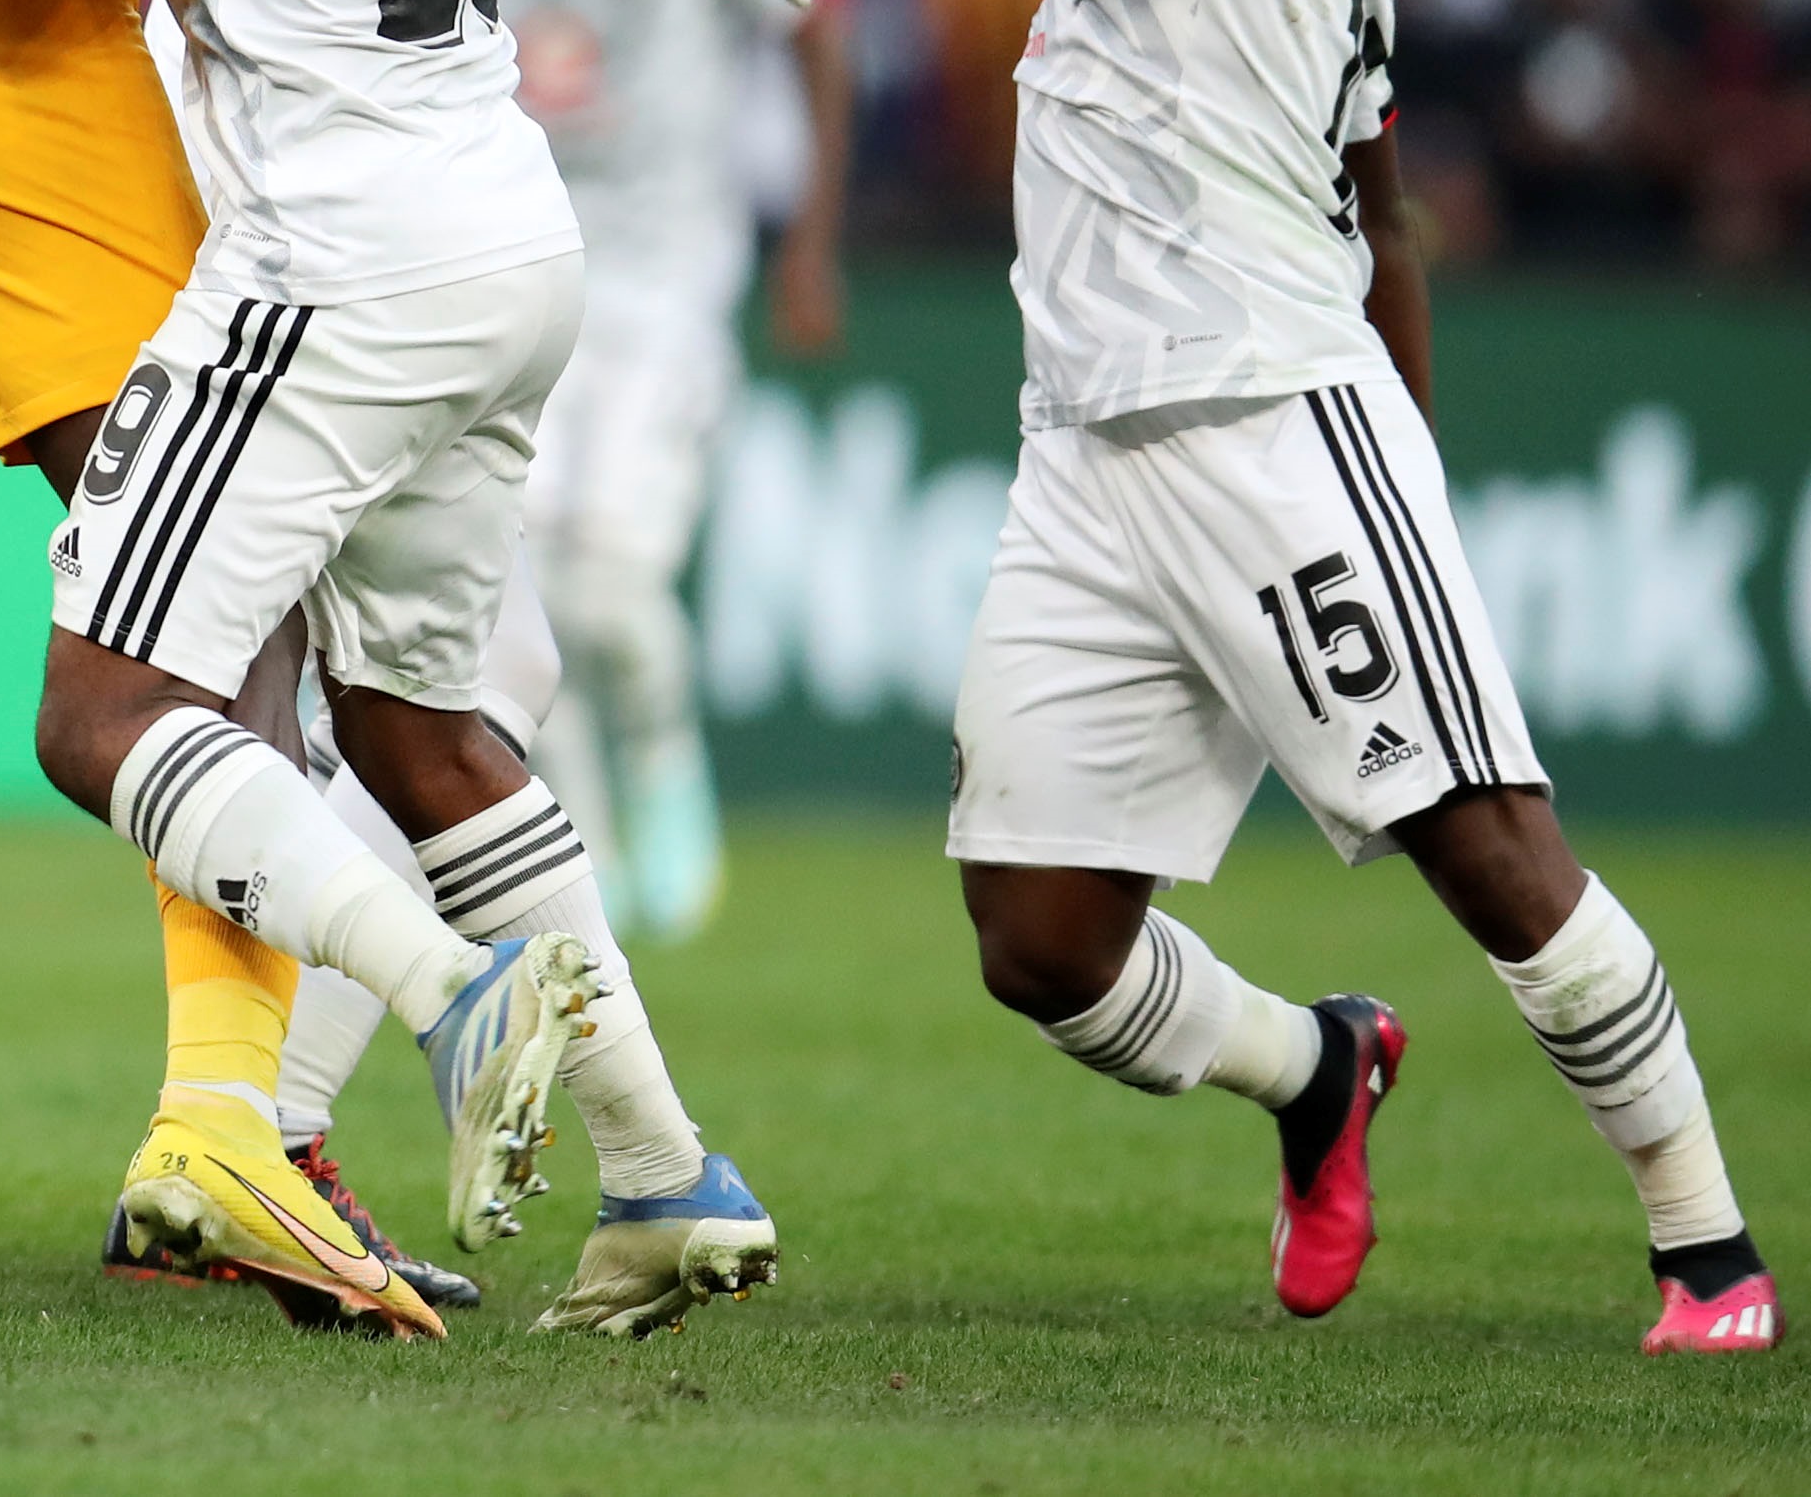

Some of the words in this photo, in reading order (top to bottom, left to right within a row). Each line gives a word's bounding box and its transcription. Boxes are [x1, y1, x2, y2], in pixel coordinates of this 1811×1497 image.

[1256, 549, 1400, 726] 15
[1356, 742, 1424, 779] adidas
[159, 1151, 190, 1172] 28
